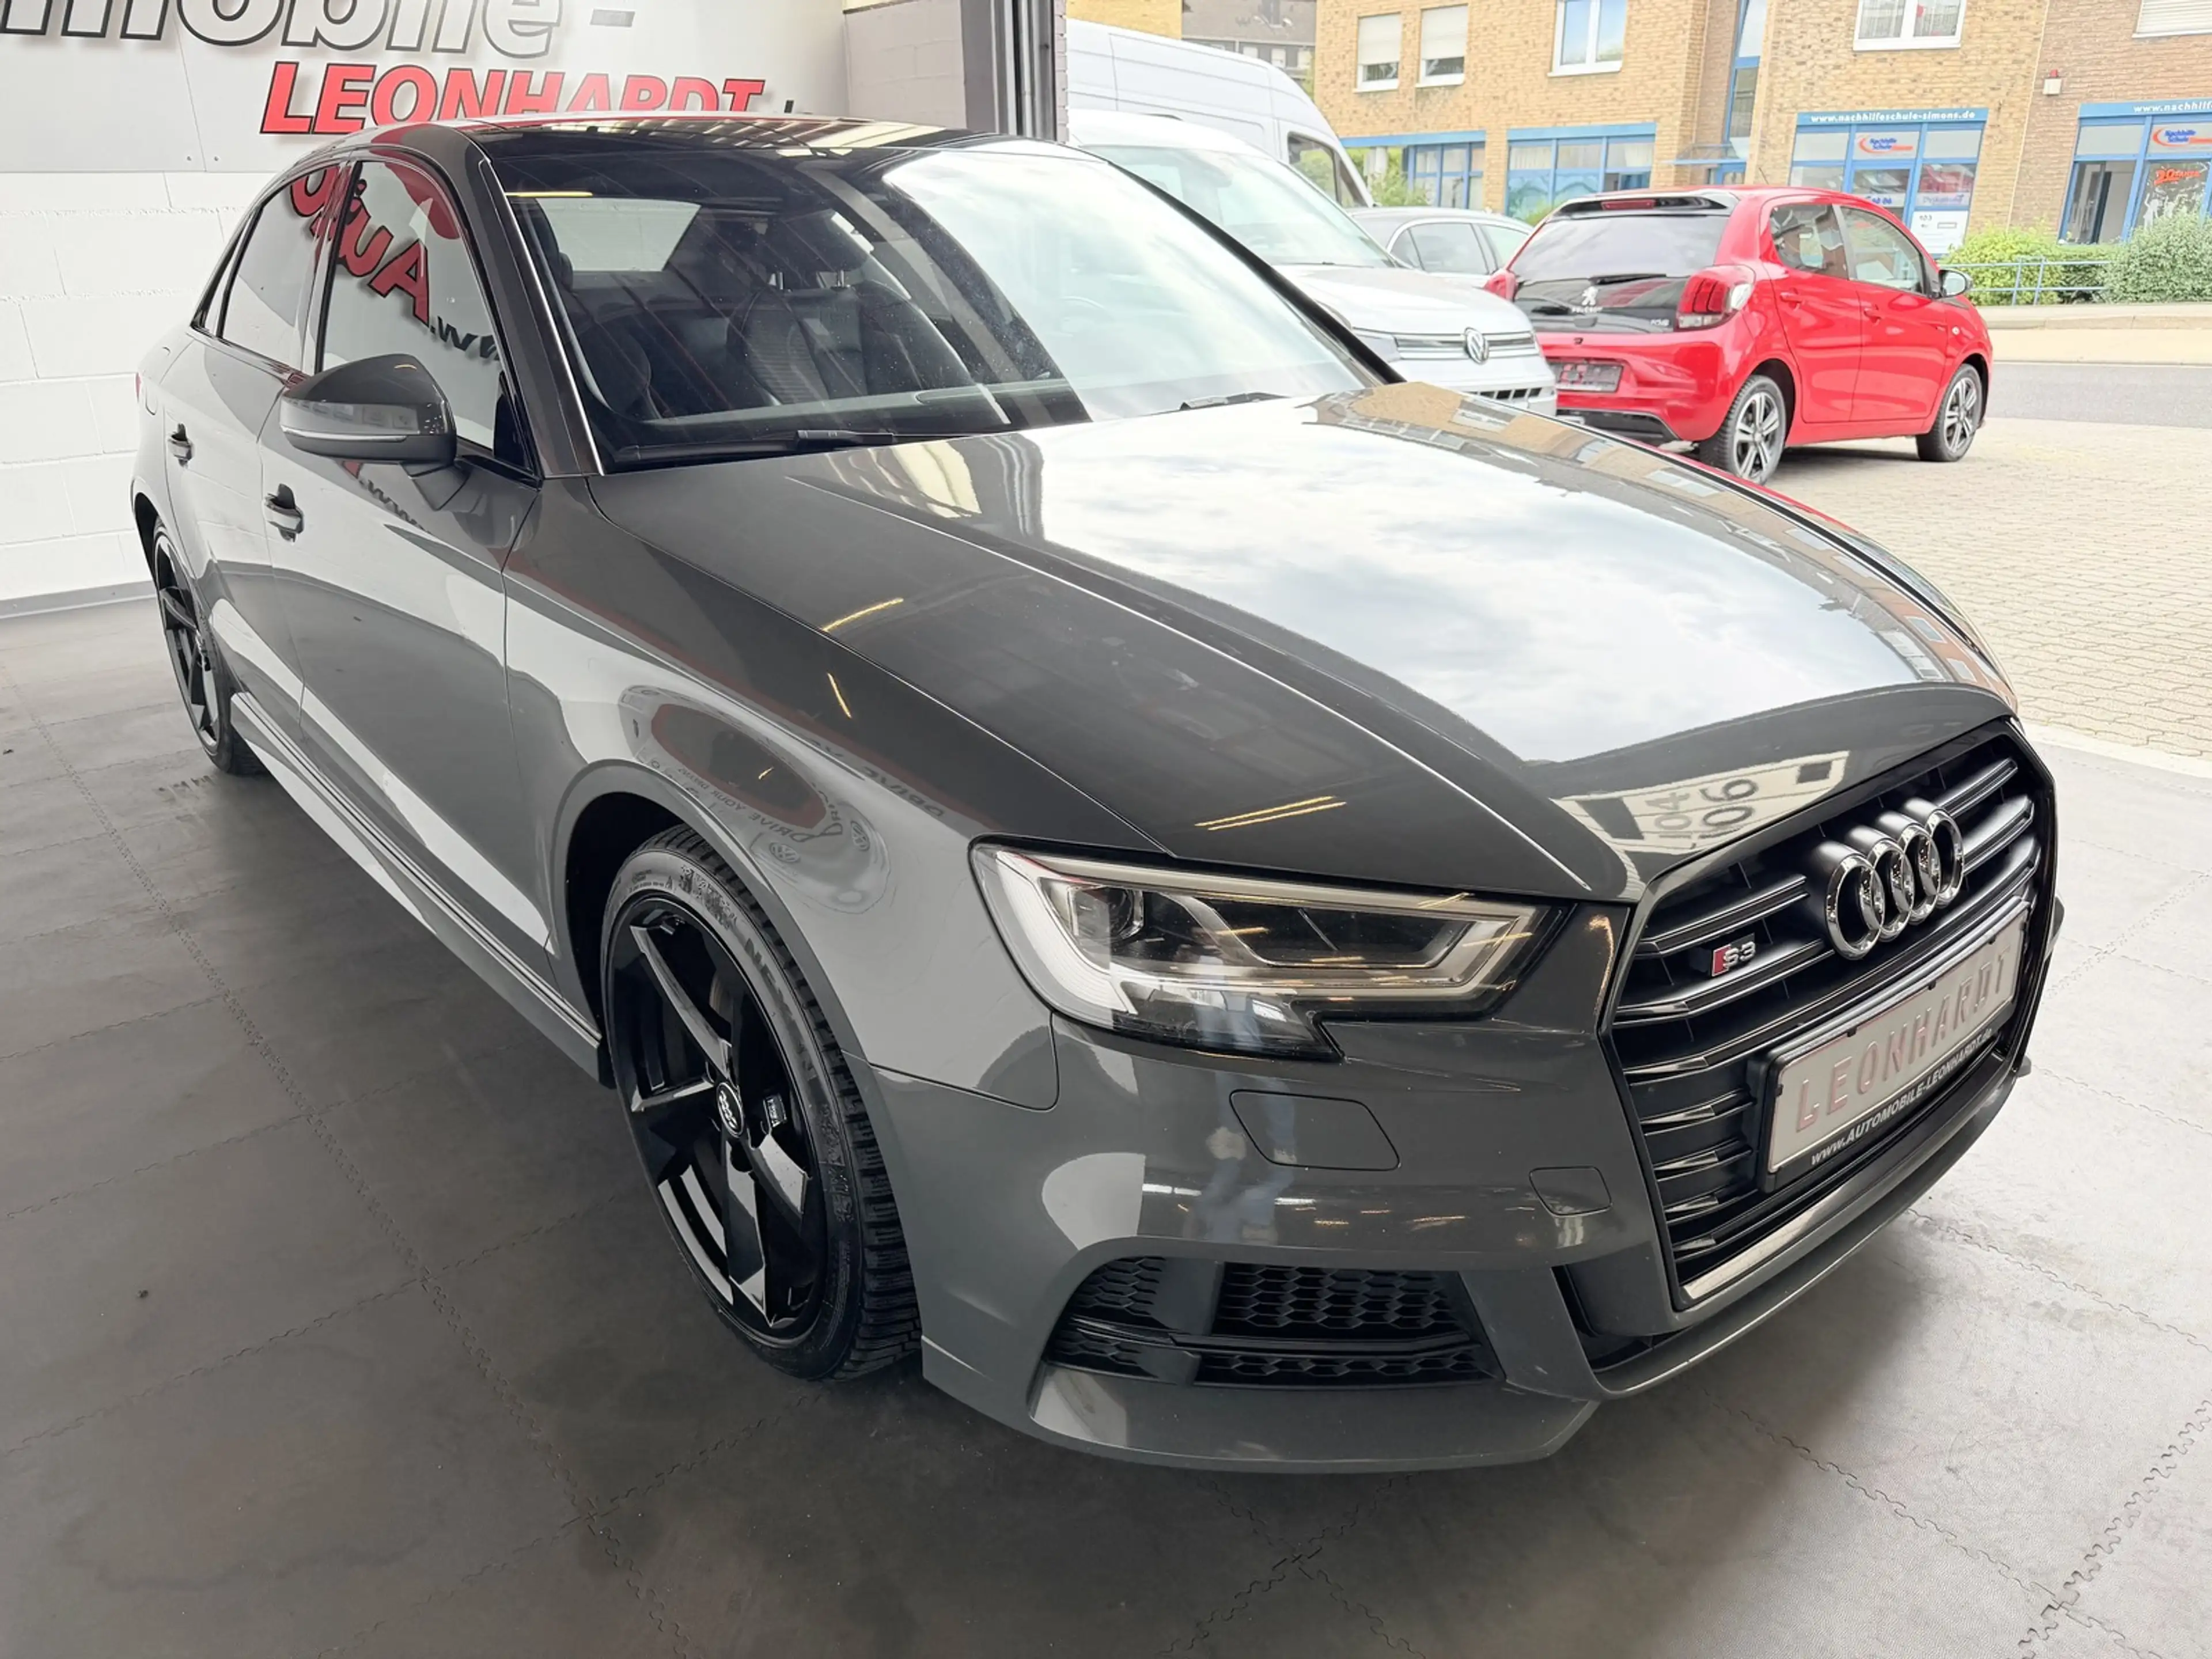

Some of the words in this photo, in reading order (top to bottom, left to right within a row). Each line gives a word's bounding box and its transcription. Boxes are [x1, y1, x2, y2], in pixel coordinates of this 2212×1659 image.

[260, 61, 766, 134] LEONHARDT
[1810, 110, 1976, 123] www.nachhilfeschule-simons.de
[1722, 941, 1756, 967] S3
[1796, 943, 2013, 1133] LEONHARDT
[1810, 1027, 1993, 1165] www.AUTOMOBILE-LEONHARDT.de
